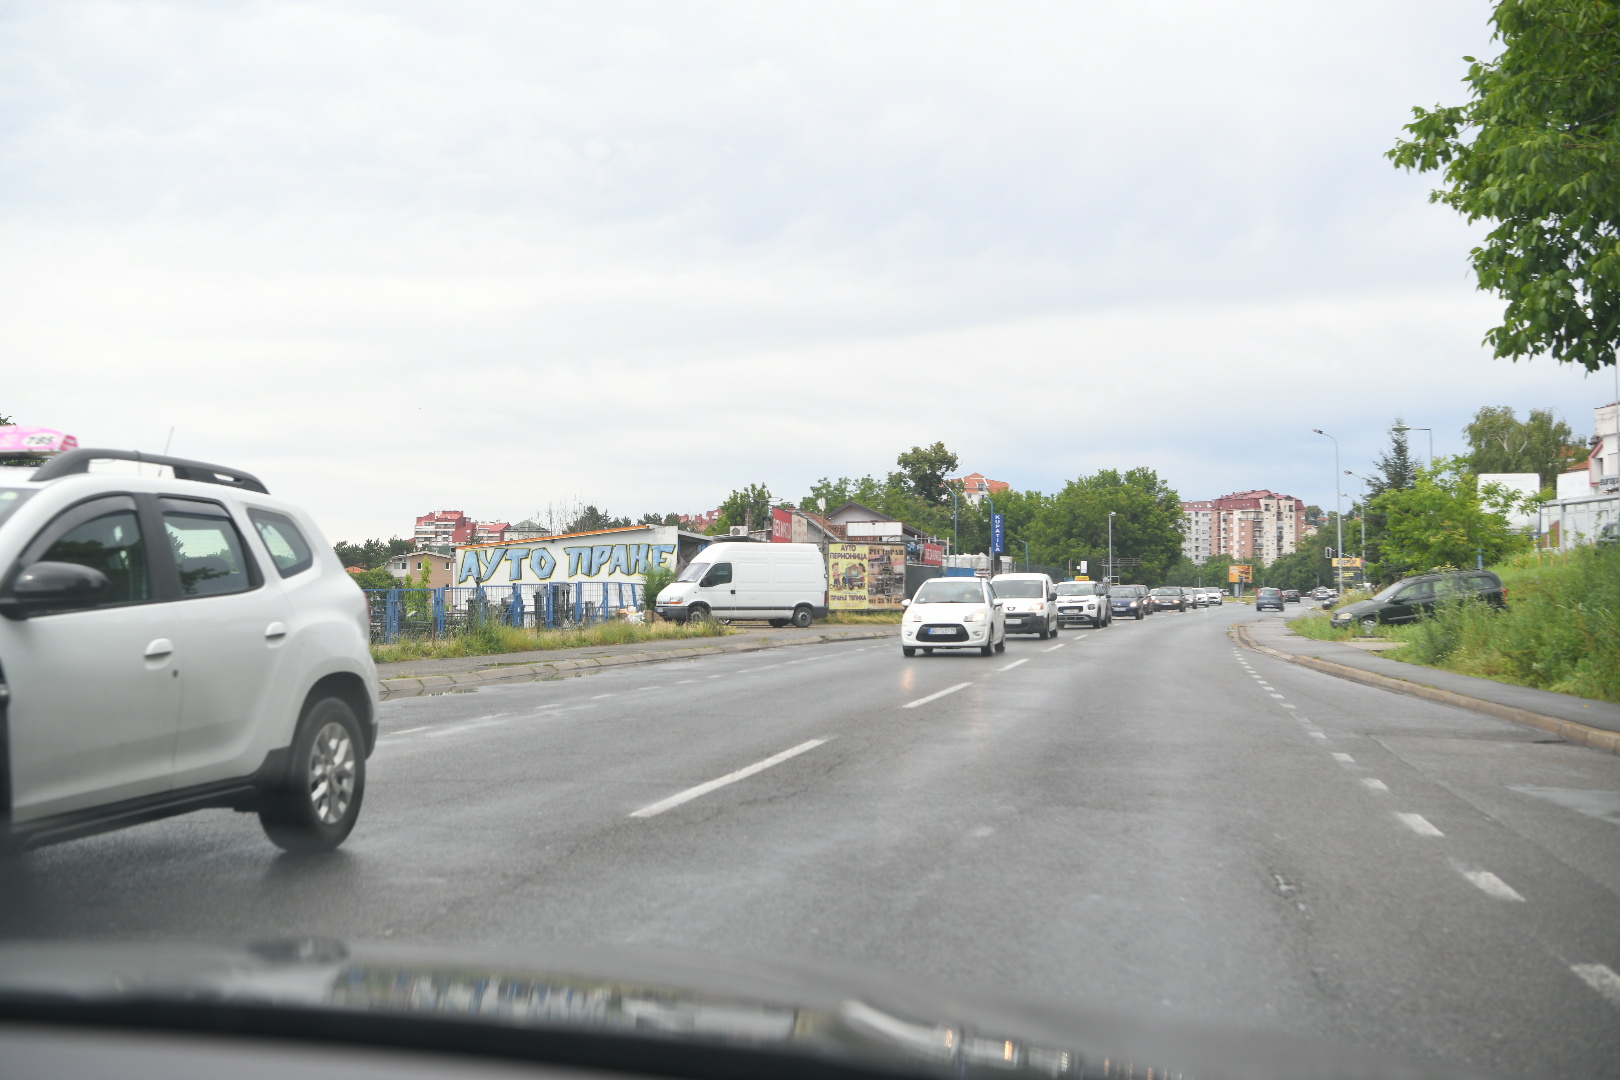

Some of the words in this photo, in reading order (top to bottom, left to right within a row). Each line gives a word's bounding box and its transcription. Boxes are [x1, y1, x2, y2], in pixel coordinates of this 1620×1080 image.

[840, 544, 857, 552] АУТО
[829, 552, 868, 561] ПЕРИОНИЦА
[457, 546, 557, 584] АУТО
